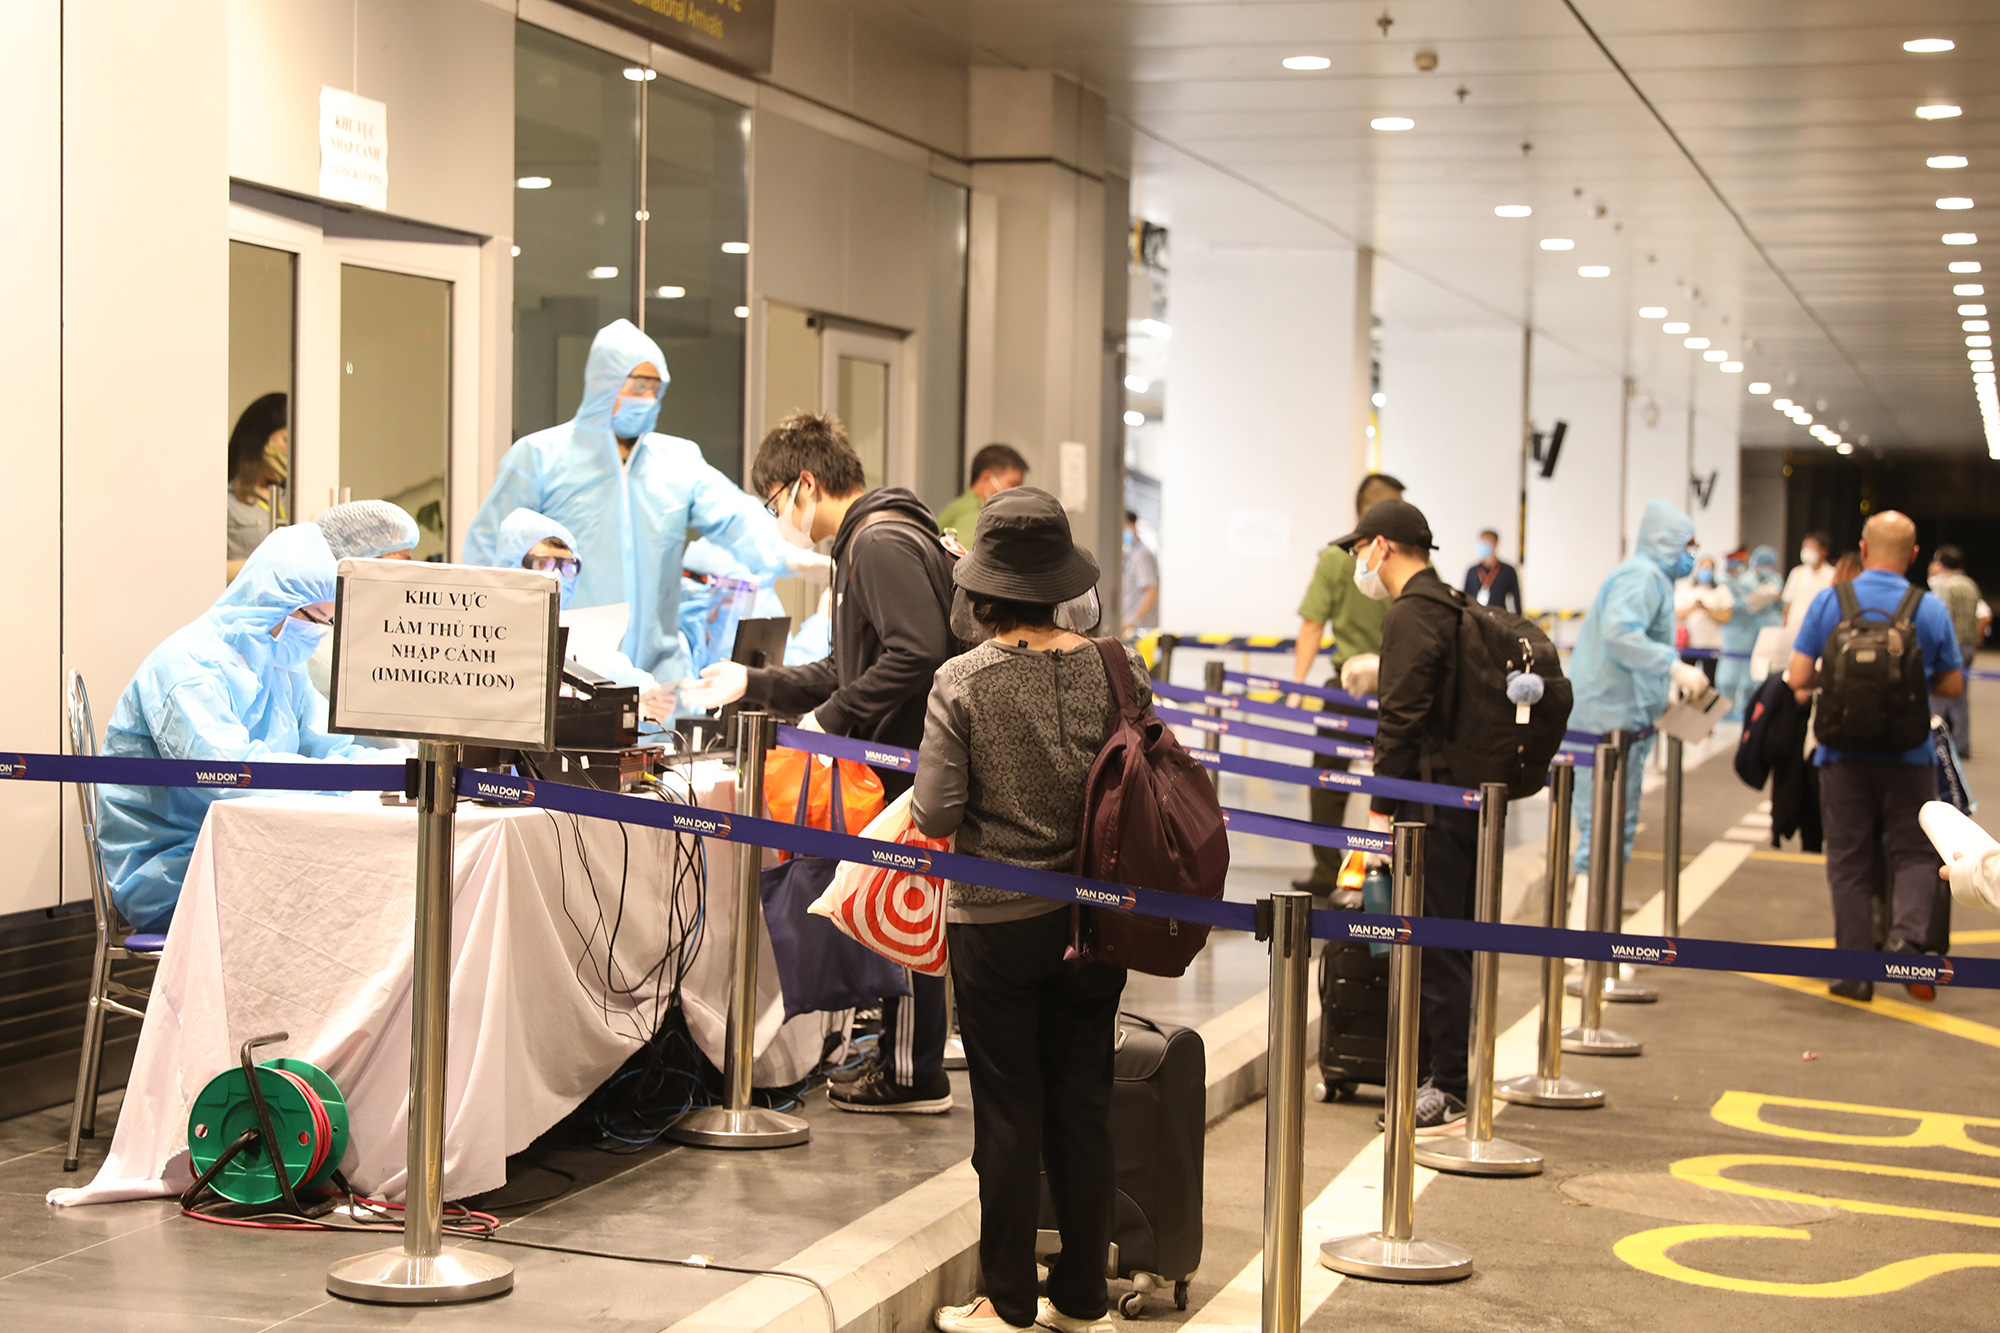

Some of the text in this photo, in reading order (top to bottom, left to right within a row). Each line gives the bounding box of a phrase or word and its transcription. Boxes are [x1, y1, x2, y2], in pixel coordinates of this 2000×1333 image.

[405, 590, 487, 611] KHU VỰC
[384, 616, 507, 643] LÀM THỦ TỤC
[391, 643, 496, 664] NHẬP CẢNH
[372, 666, 515, 692] (IMMIGRATION)
[865, 750, 881, 760] VAN
[882, 753, 899, 764] DON
[0, 764, 12, 772] ON
[196, 772, 237, 781] VAN DON
[478, 782, 520, 797] VAN DON
[673, 815, 716, 830] VAN DON
[1347, 836, 1364, 846] VAN
[1365, 838, 1383, 848] DON
[872, 850, 916, 866] VAN DON
[1075, 887, 1120, 903] VAN DON
[1348, 924, 1395, 937] VAN DON
[1611, 945, 1660, 958] VAN DON
[1885, 964, 1936, 978] VAN DON
[1612, 1090, 2000, 1297] BUS
